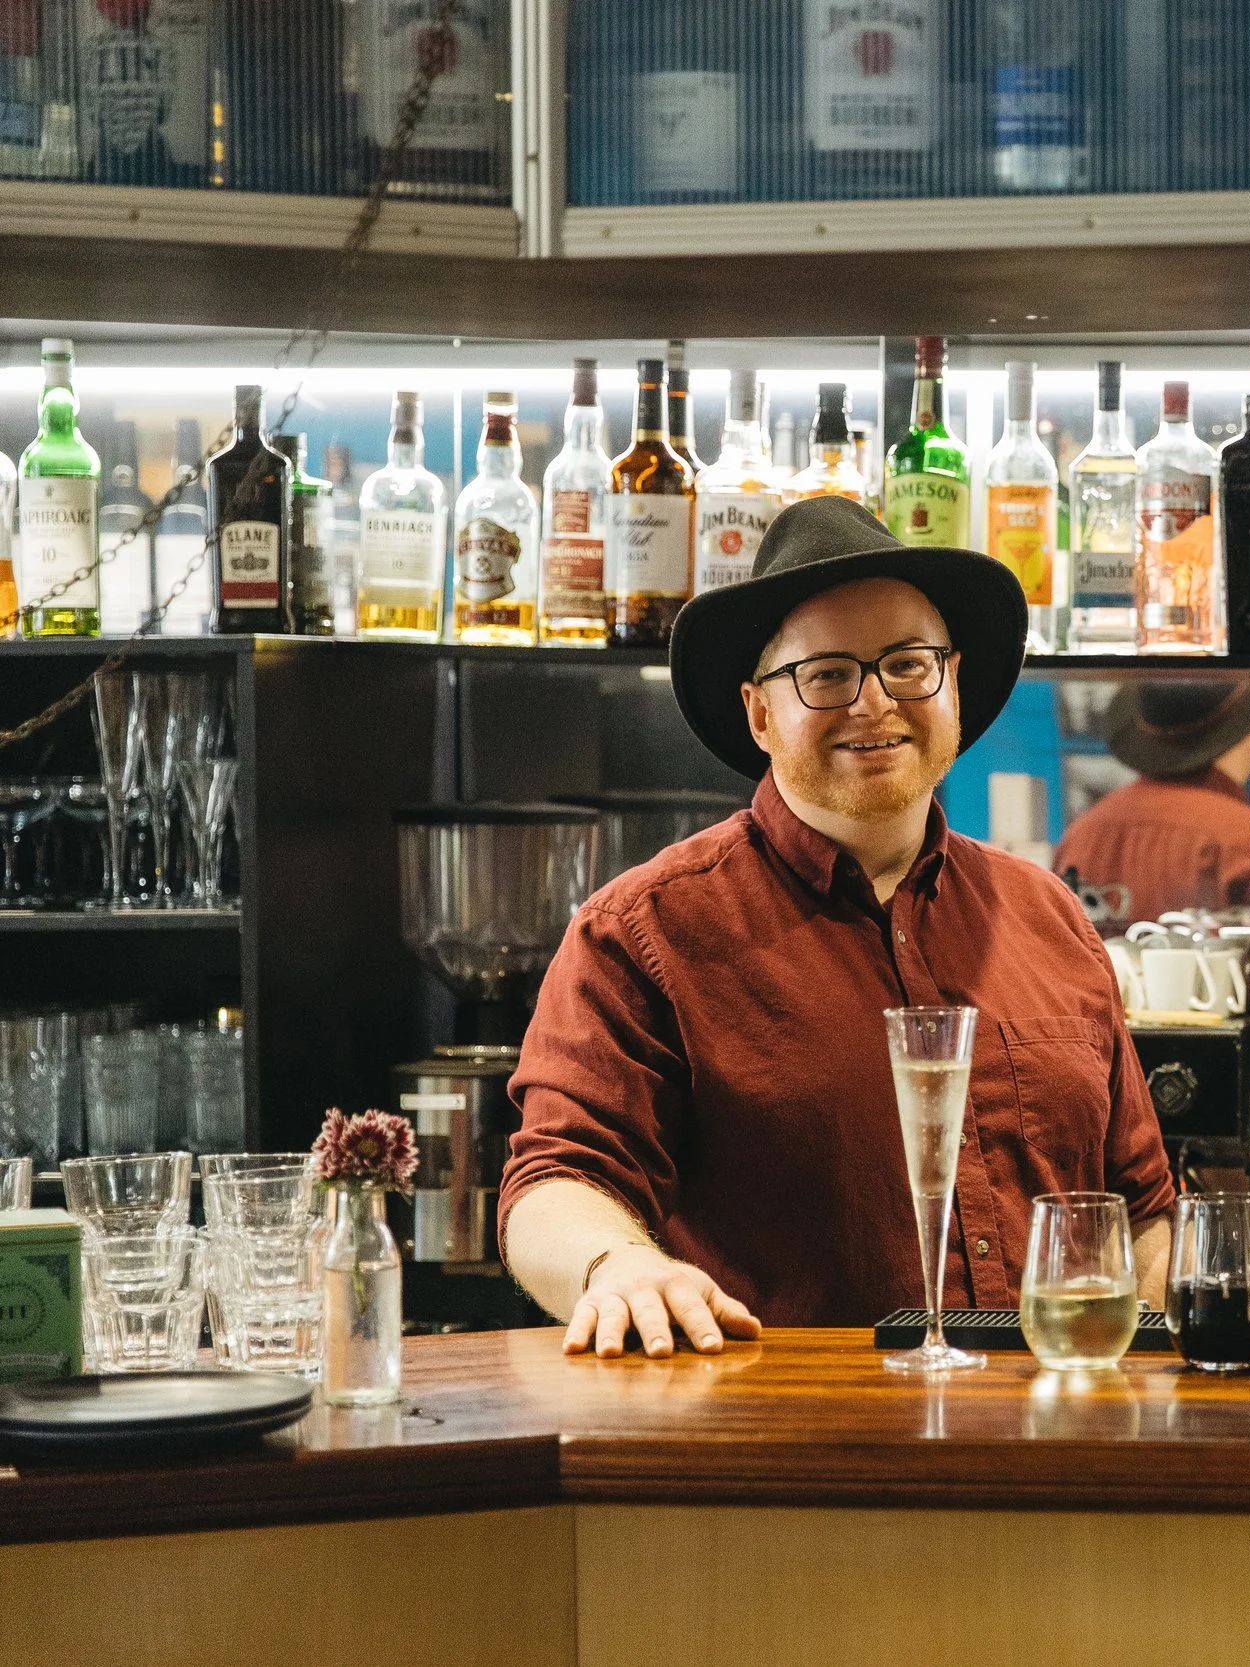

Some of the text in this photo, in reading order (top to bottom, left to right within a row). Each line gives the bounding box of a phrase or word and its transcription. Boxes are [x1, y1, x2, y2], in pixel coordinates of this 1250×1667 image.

[889, 480, 959, 502] JAMESON
[366, 519, 433, 535] BENRIACH
[699, 510, 724, 536] JIM
[1007, 514, 1038, 528] SEC
[225, 526, 273, 542] SLANE
